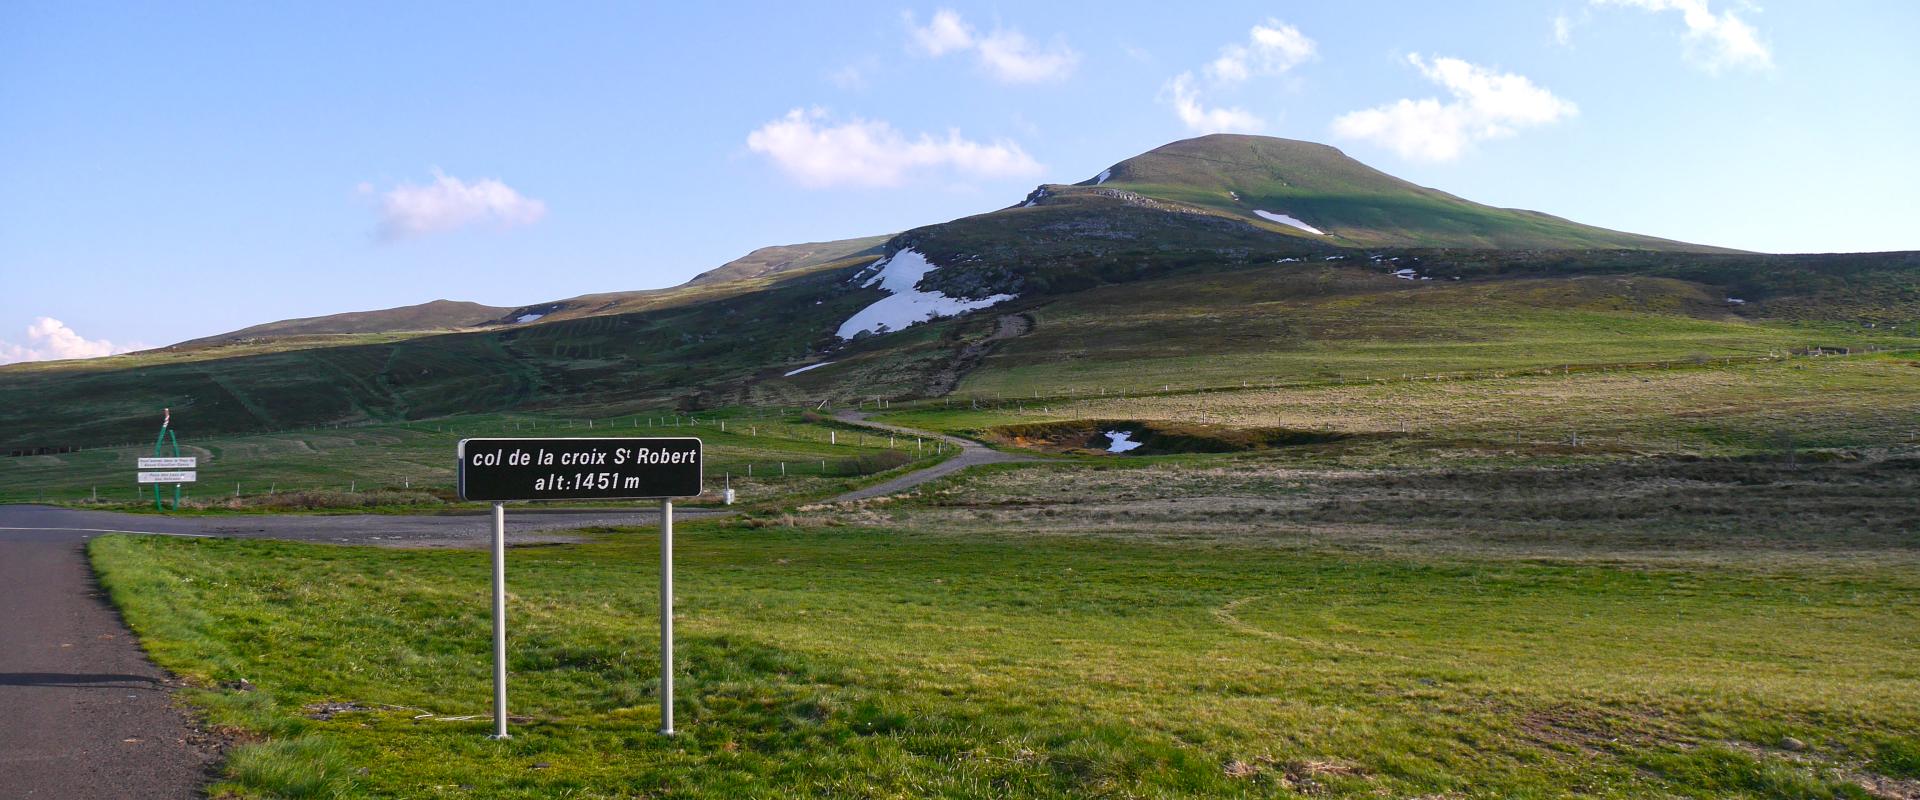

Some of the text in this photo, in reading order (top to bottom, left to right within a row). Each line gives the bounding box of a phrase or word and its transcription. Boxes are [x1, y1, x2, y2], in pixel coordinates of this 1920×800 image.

[472, 447, 697, 467] col de la croix St Robert
[623, 476, 640, 489] m
